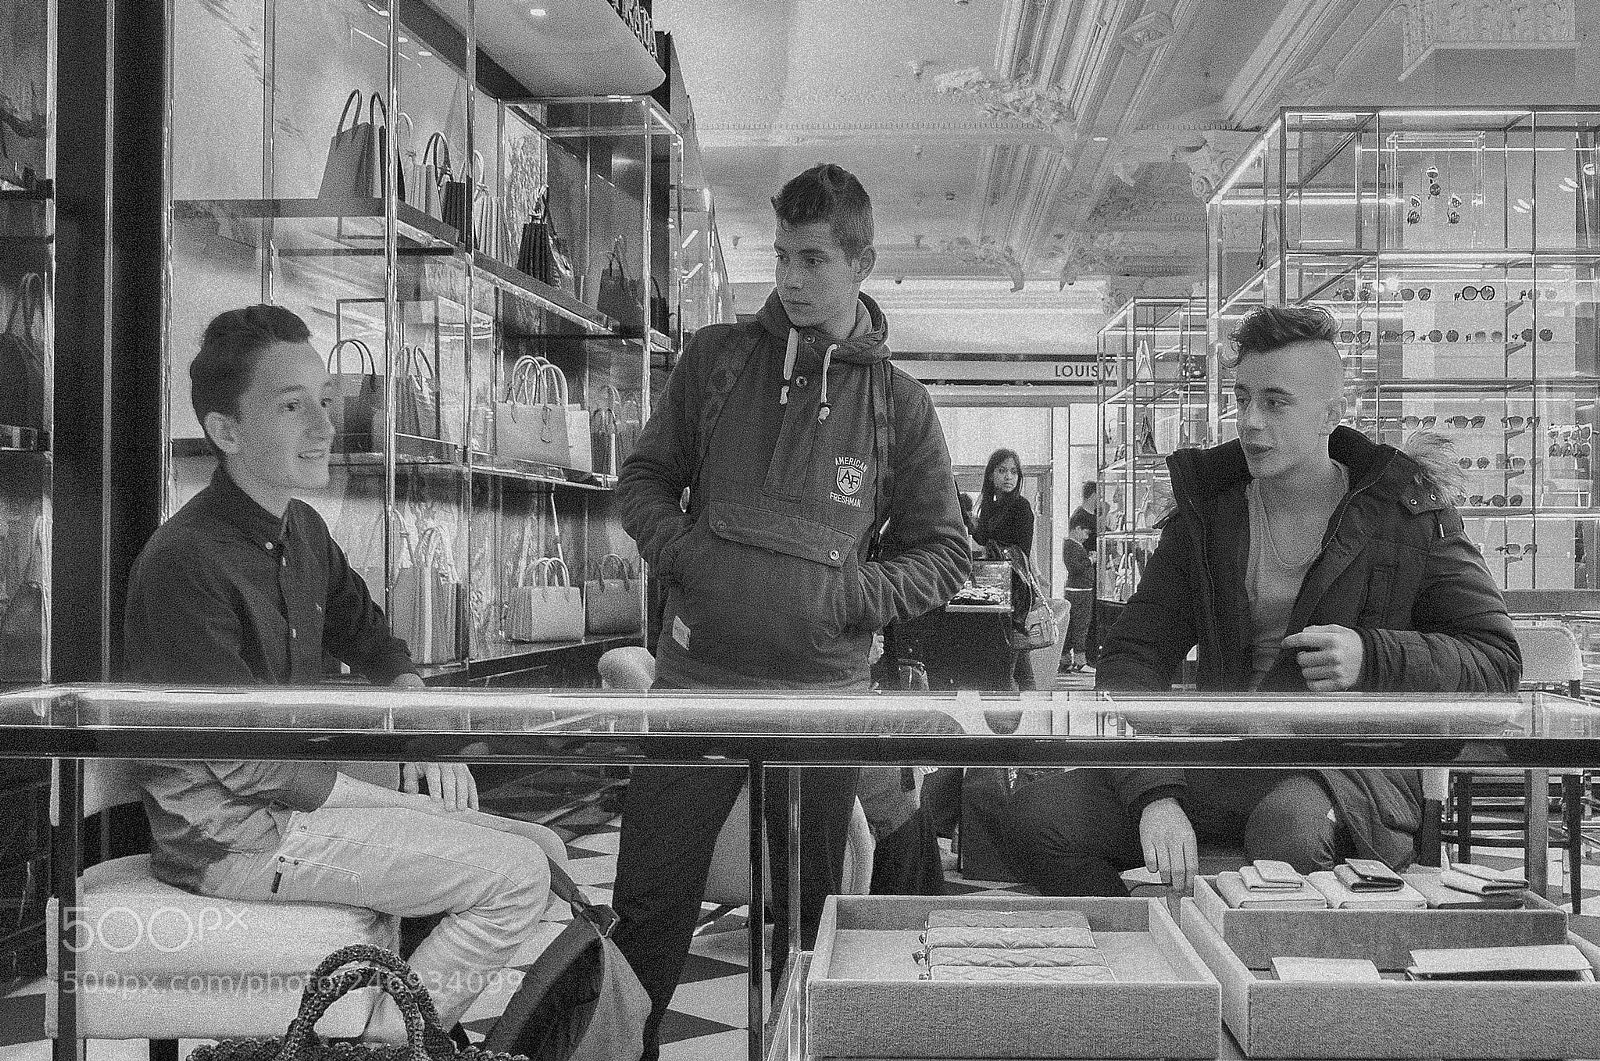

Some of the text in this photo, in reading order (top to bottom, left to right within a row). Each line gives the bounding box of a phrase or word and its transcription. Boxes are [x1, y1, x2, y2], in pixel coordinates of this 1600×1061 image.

[606, 0, 658, 58] RADA
[1055, 364, 1099, 378] LOUIS
[835, 456, 868, 473] AMERICAN
[839, 469, 861, 489] AF
[829, 491, 861, 508] FRESHMAN
